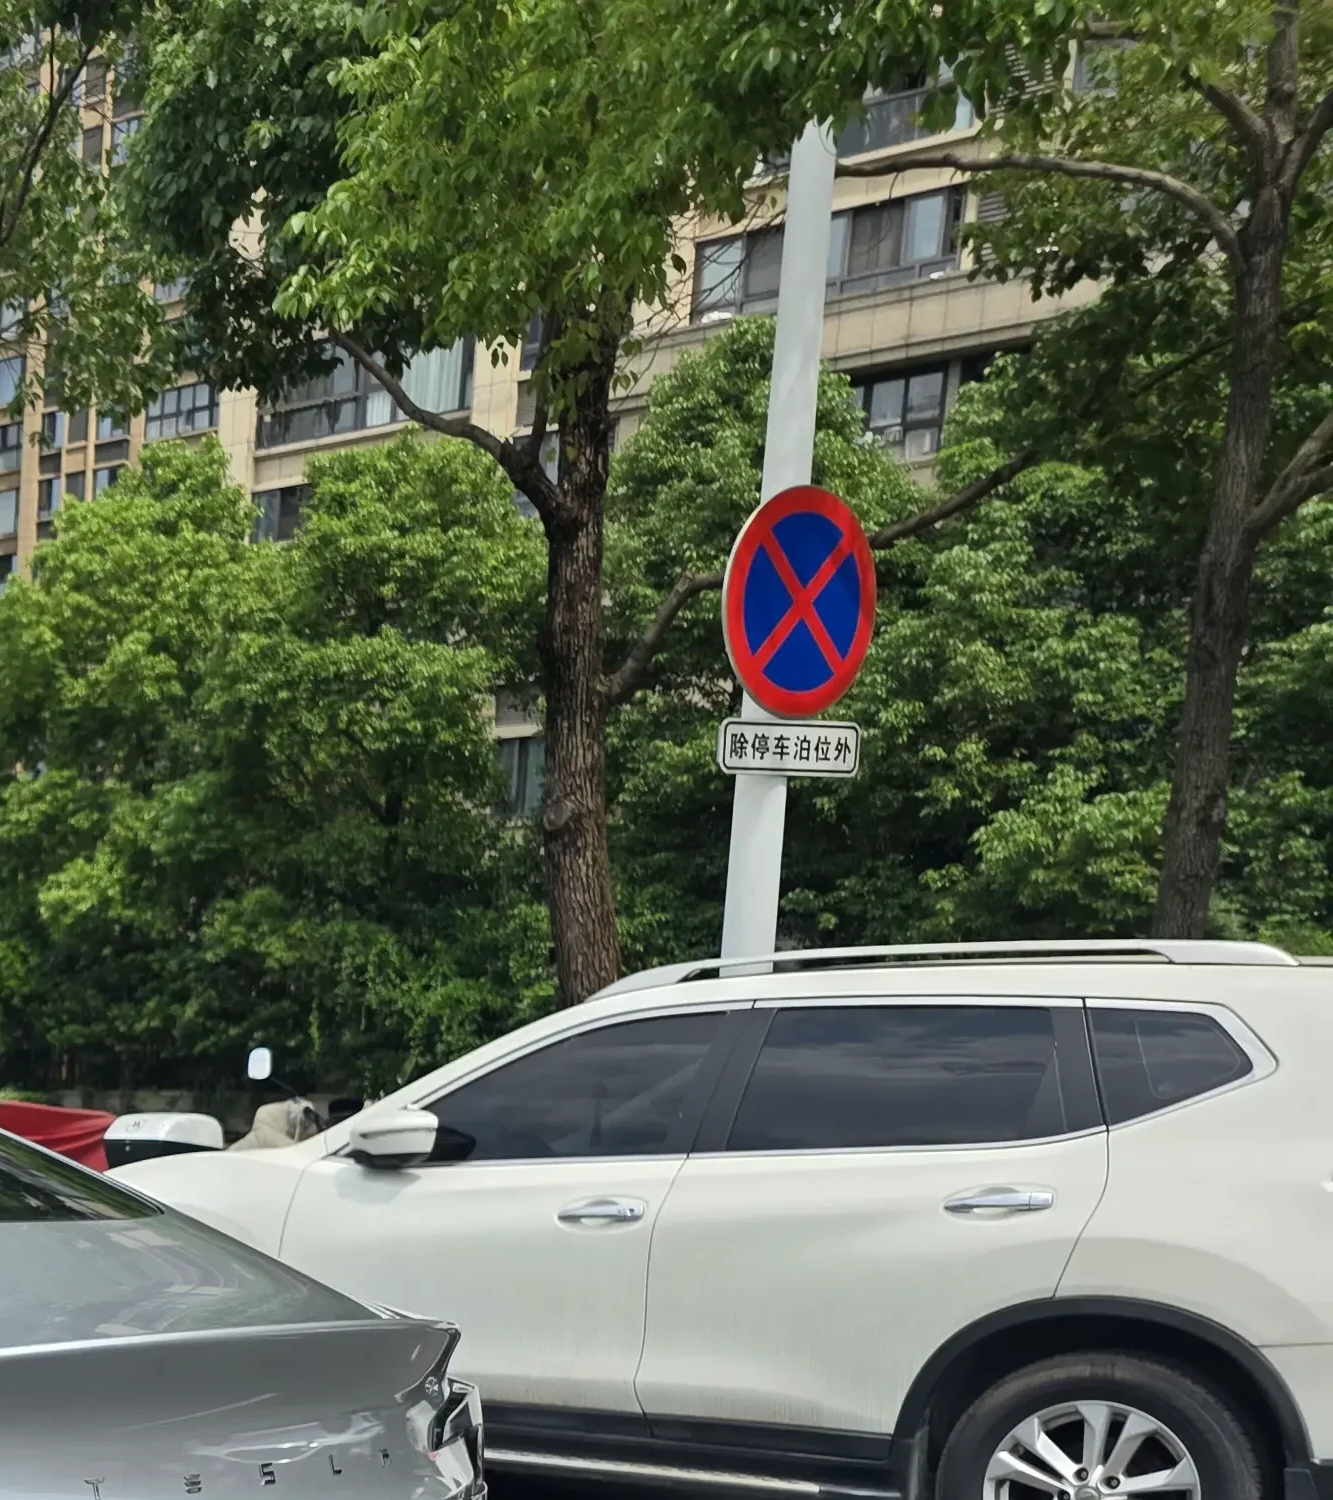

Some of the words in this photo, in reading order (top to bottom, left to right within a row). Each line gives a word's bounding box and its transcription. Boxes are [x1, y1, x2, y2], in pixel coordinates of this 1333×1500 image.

[729, 732, 853, 764] 除停车泊位外
